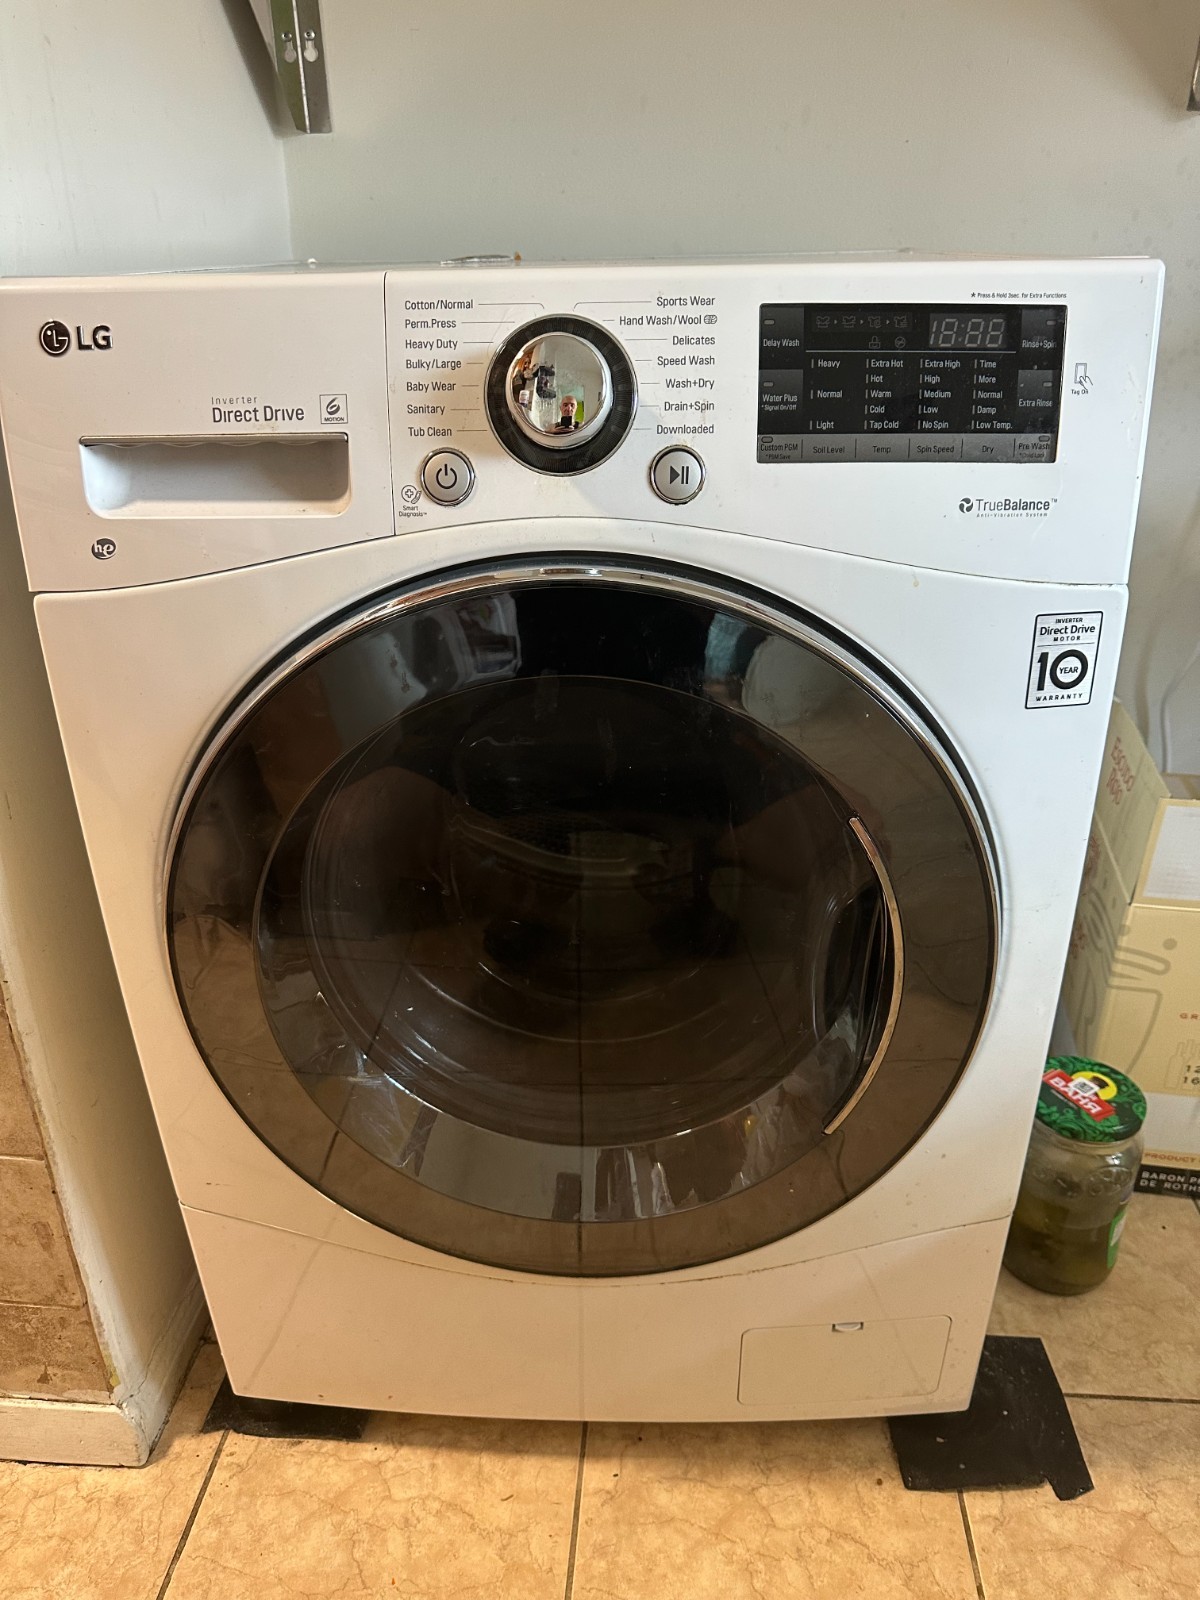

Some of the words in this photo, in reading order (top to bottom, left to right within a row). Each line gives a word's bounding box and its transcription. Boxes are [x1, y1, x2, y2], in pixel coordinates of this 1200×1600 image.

[404, 299, 474, 310] Cotton/Normal
[656, 296, 688, 308] Sports
[689, 296, 716, 306] Wear
[405, 319, 457, 329] Perm.Press
[619, 315, 643, 326] Hand
[646, 314, 702, 325] Wash/Wool
[77, 325, 113, 350] LG
[672, 335, 716, 346] Delicates
[405, 339, 434, 350] Heavy
[436, 339, 458, 350] Duty
[763, 339, 781, 348] Delay
[782, 338, 800, 347] Wash
[1022, 340, 1057, 349] Rinse+Spin
[405, 359, 462, 370] Bulky/Large
[657, 355, 687, 367] Speed
[689, 355, 715, 365] Wash
[818, 359, 840, 369] Heavy
[871, 360, 889, 368] Extra
[891, 360, 903, 368] Hot
[925, 360, 943, 368] Extra
[944, 360, 961, 370] High
[980, 360, 996, 368] Time
[665, 378, 715, 390] Wash+Dry
[870, 375, 883, 383] Hot
[924, 375, 940, 384] High
[978, 375, 996, 383] More
[406, 381, 430, 393] Baby
[432, 381, 456, 391] Wear
[762, 394, 783, 402] Water
[784, 393, 798, 402] Plus
[817, 389, 843, 398] Normal
[870, 390, 892, 398] Warm
[924, 389, 951, 398] Medium
[977, 390, 1003, 399] Normal
[211, 396, 258, 405] Inverter
[1018, 399, 1035, 407] Extra
[1036, 399, 1052, 407] Rinse
[407, 404, 445, 415] Sanitary
[664, 401, 715, 413] Drain+Spin
[870, 405, 885, 414] Cold
[923, 405, 938, 414] Low
[977, 405, 996, 415] Damp
[212, 406, 259, 423] Direct
[264, 405, 305, 422] Drive
[656, 424, 714, 435] Downloaded
[816, 421, 834, 430] Light
[870, 421, 882, 430] Tap
[883, 420, 899, 429] Cold
[922, 420, 932, 429] No
[933, 420, 949, 431] Spin
[976, 421, 991, 429] Low
[993, 421, 1013, 431] Temp.
[408, 427, 425, 437] Tub
[427, 426, 452, 437] Clean
[761, 443, 783, 451] Custom
[784, 443, 798, 451] PGM
[813, 446, 825, 454] Soil
[826, 446, 845, 454] Level
[873, 446, 891, 454] Temp
[917, 445, 932, 455] Spin
[933, 445, 954, 454] Speed
[982, 445, 994, 454] Dry
[1018, 442, 1030, 450] Pre
[1031, 442, 1050, 450] Wash
[1039, 626, 1068, 636] Direct
[1070, 624, 1096, 634] Drive
[1037, 649, 1089, 691] 10
[1059, 666, 1078, 675] YEAR
[1035, 693, 1083, 702] WARRANTY
[1145, 1152, 1196, 1163] PRODUCT
[1141, 1170, 1185, 1182] BARON
[1140, 1179, 1157, 1187] DE
